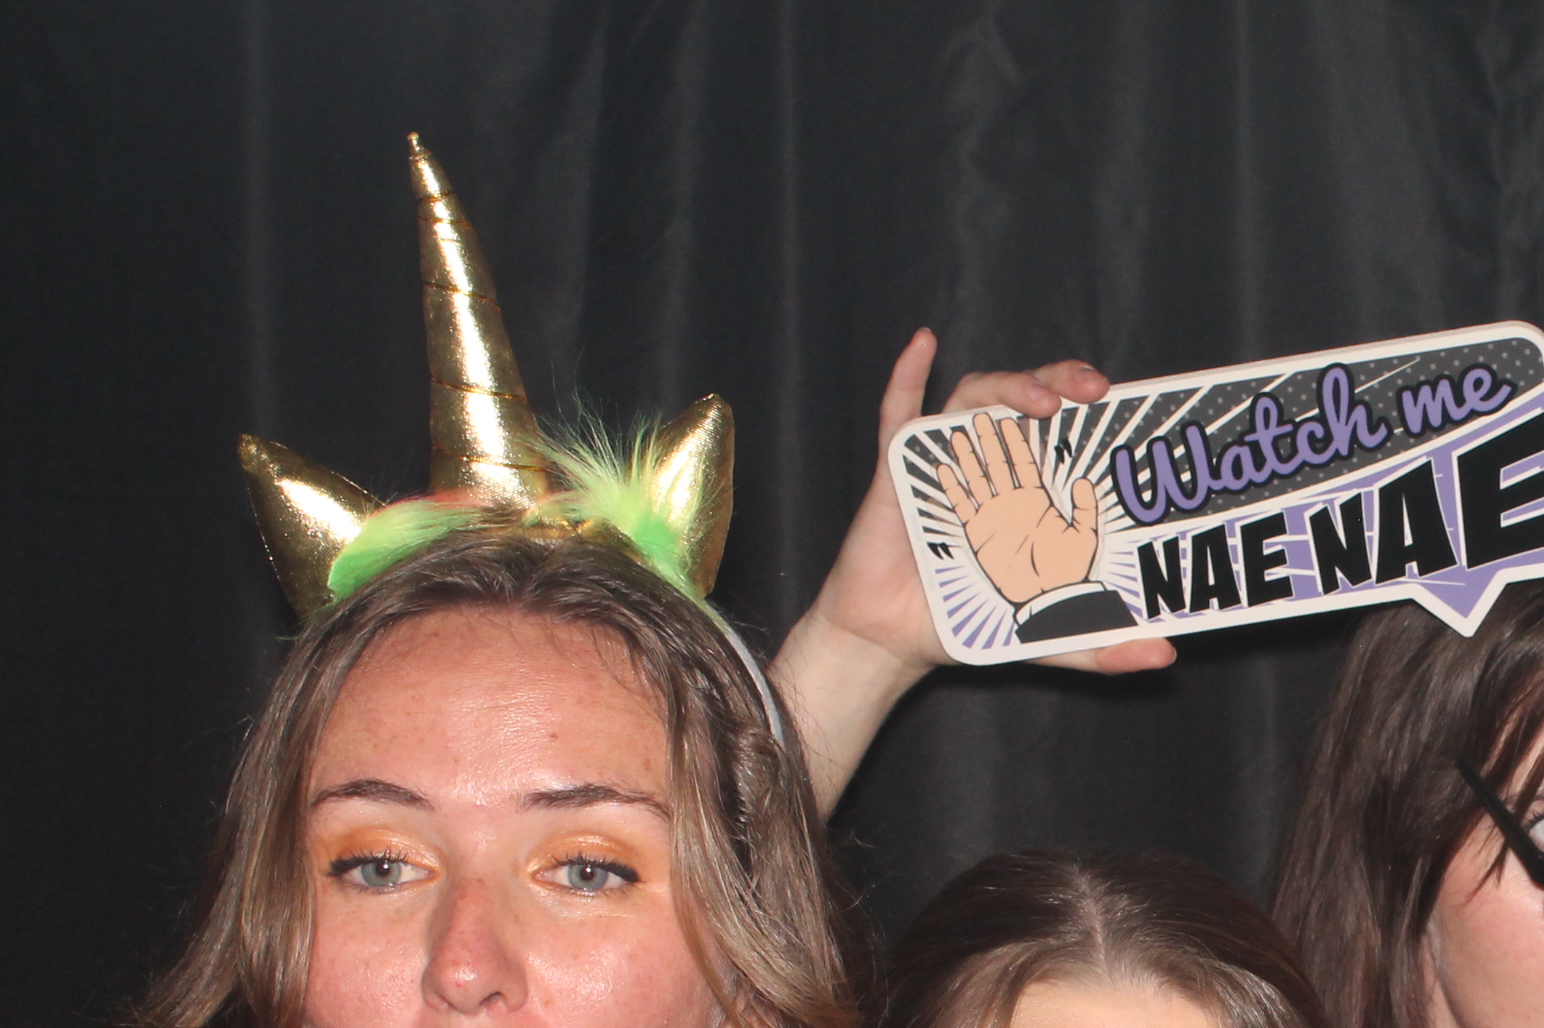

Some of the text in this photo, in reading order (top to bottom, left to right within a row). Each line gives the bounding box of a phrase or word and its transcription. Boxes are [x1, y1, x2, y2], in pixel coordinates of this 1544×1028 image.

[1113, 365, 1516, 522] Watch me
[1137, 512, 1295, 621] NAE
